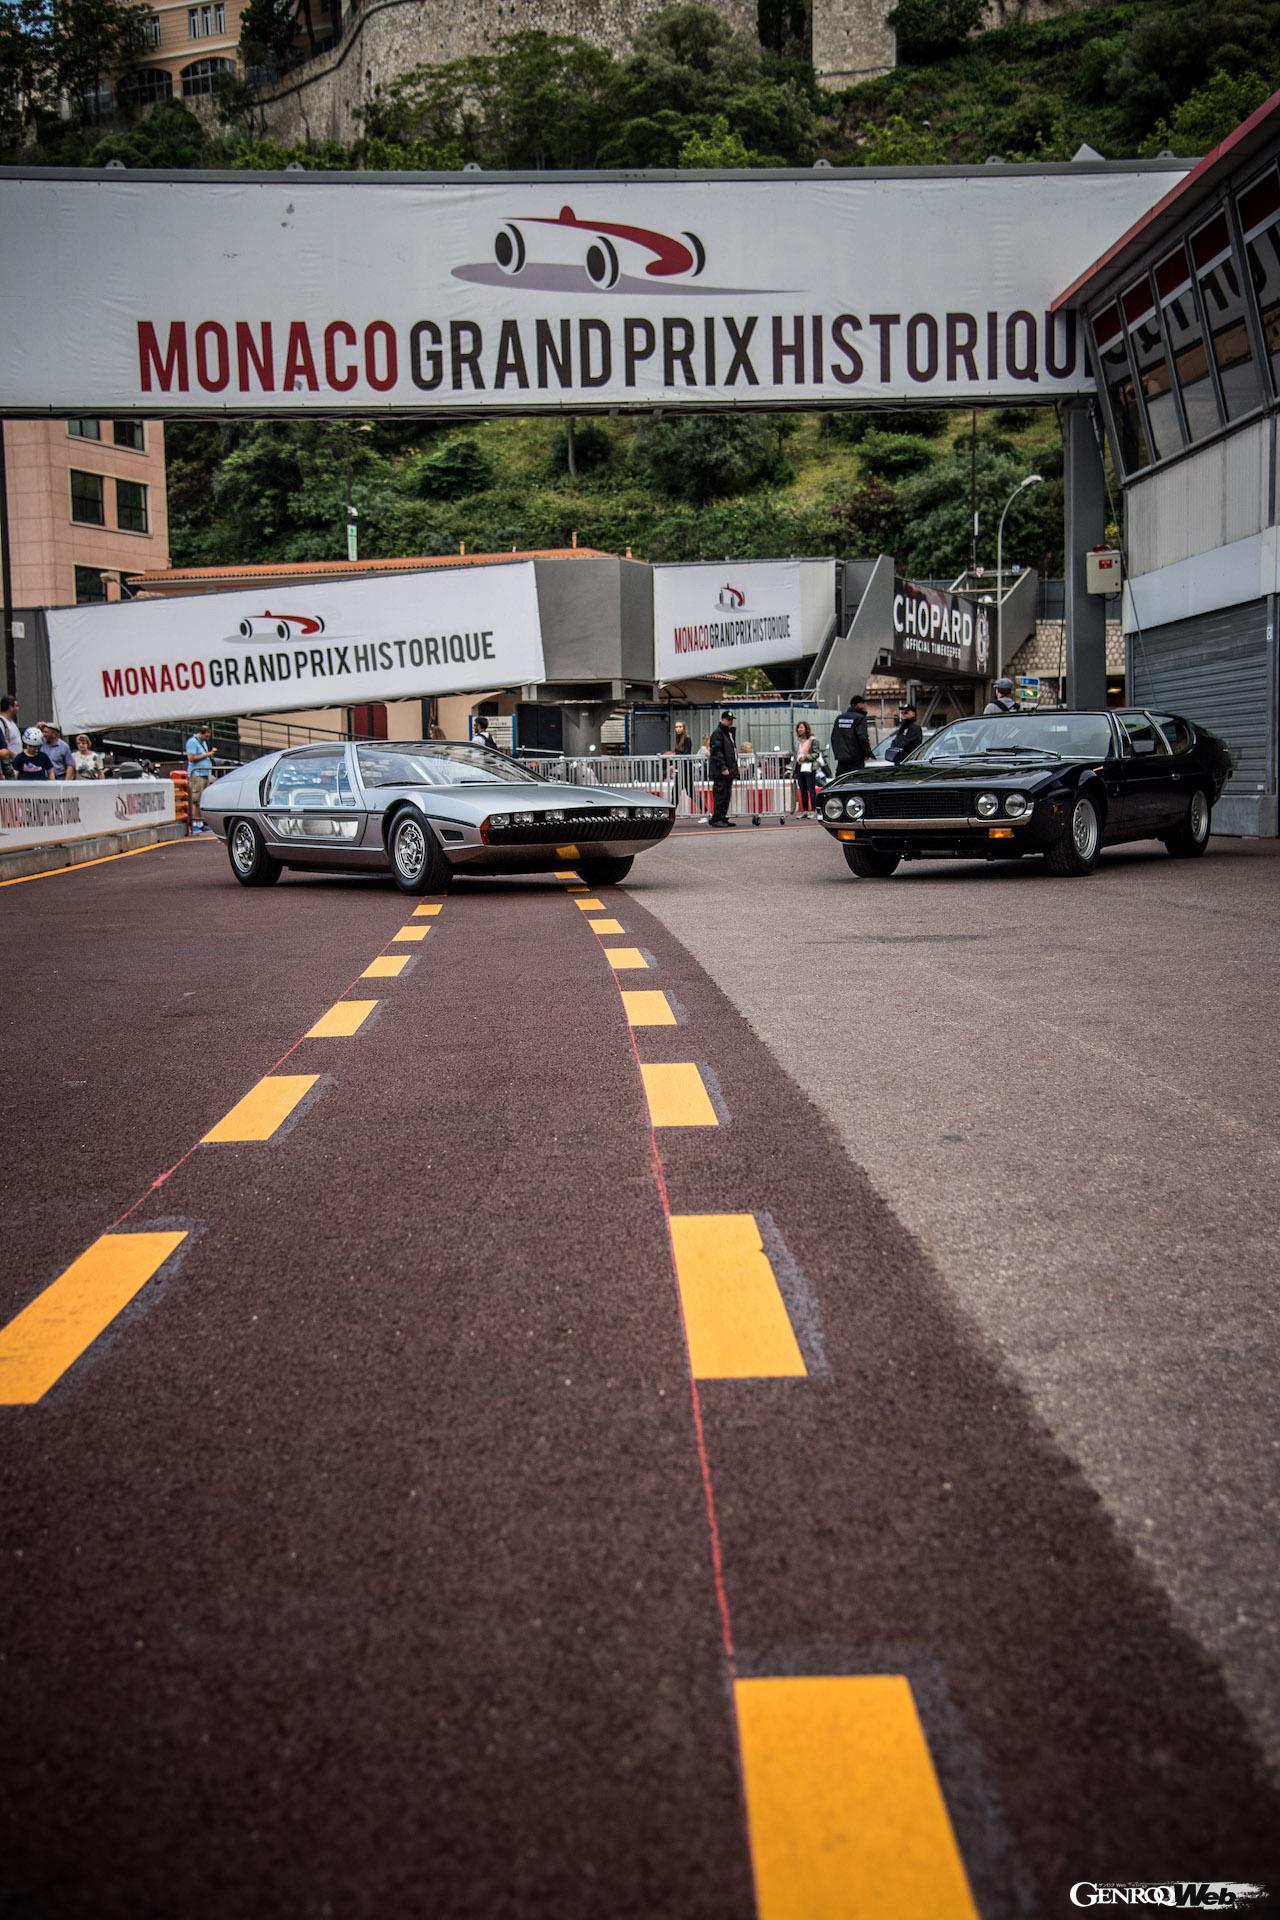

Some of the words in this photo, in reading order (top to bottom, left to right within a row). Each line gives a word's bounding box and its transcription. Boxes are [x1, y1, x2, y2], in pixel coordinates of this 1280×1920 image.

[137, 320, 398, 393] MONACO
[409, 318, 612, 392] GRAND
[623, 316, 760, 388] PRIX
[674, 624, 709, 654] MONACO
[709, 621, 736, 649] GRAND
[735, 619, 753, 645] PRIX
[752, 614, 791, 643] HISTORIQUE
[893, 594, 973, 647] CHOPARD
[101, 661, 206, 698] MONACO
[208, 652, 292, 688] GRAND
[294, 646, 352, 679] PRIX
[354, 631, 496, 674] HISTORIQUE
[904, 637, 931, 654] OFFICIAL
[931, 642, 961, 659] TIMEKEEPER
